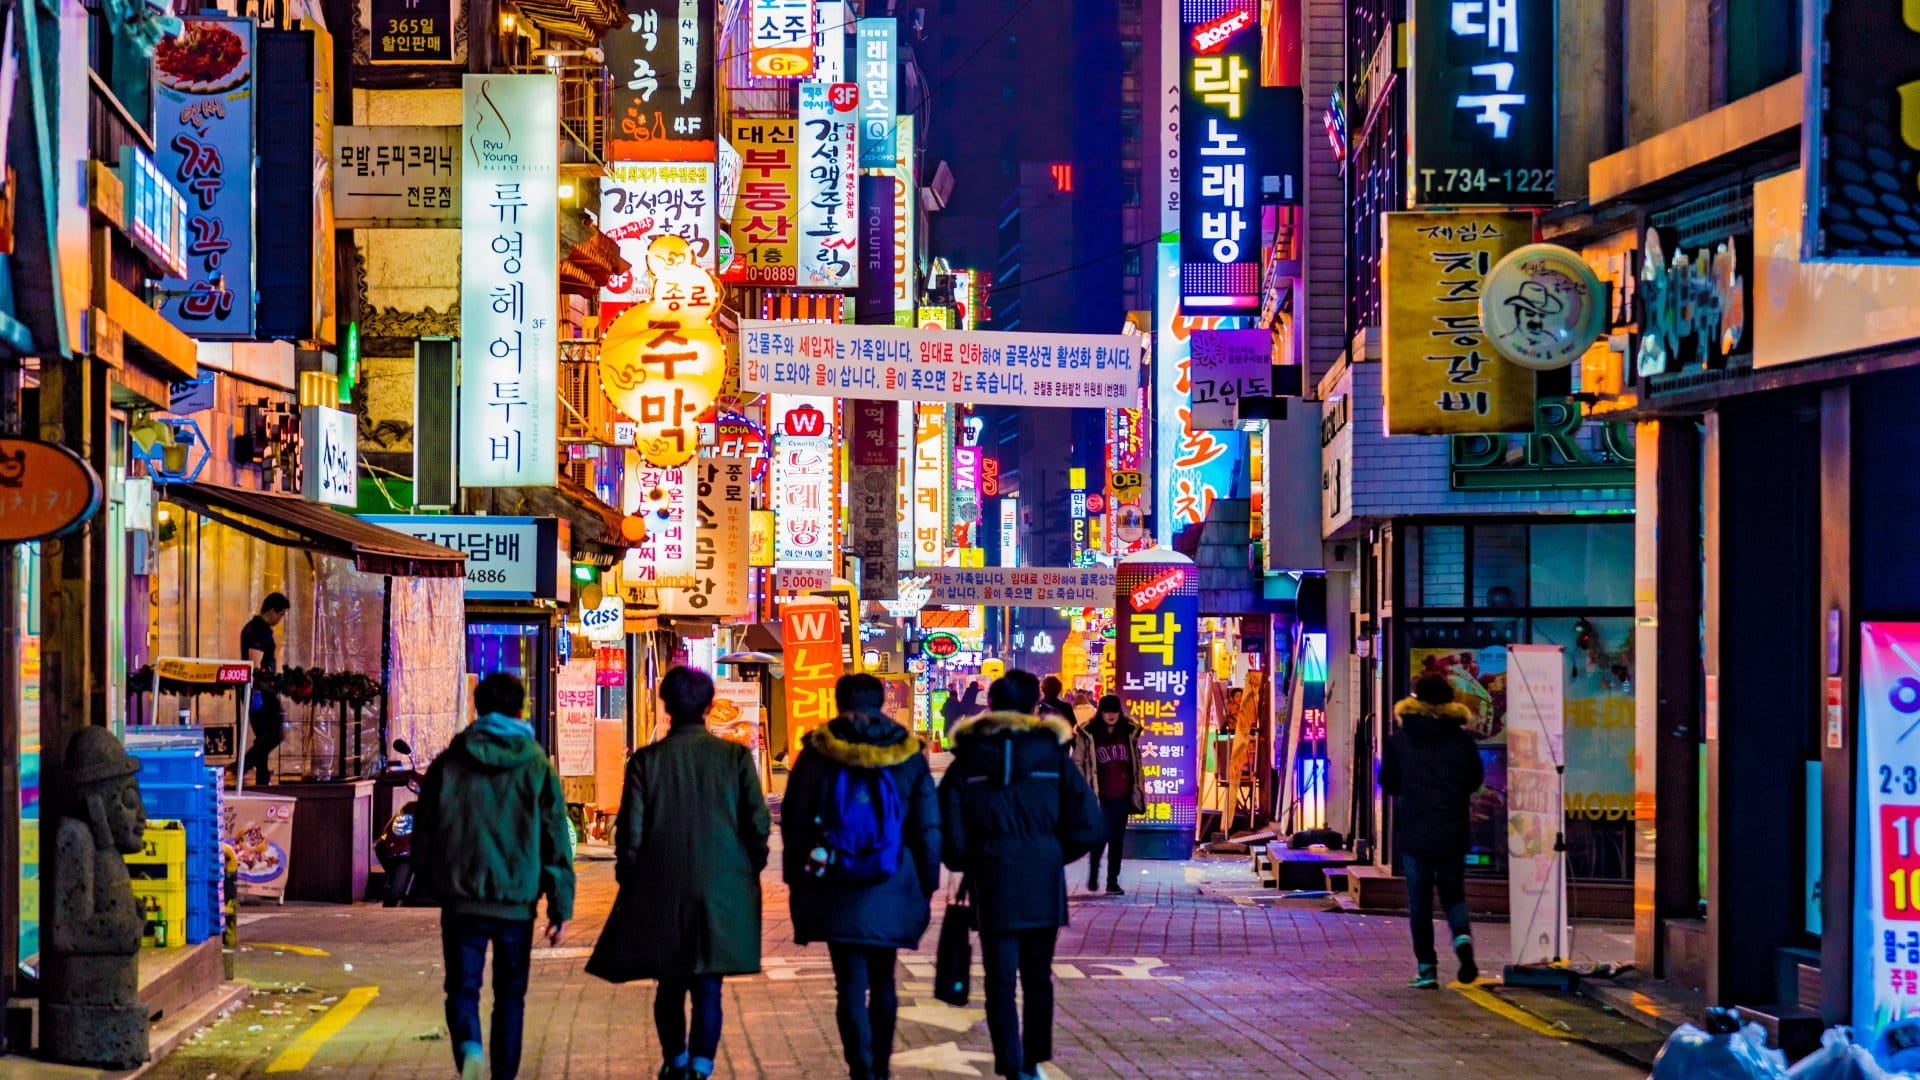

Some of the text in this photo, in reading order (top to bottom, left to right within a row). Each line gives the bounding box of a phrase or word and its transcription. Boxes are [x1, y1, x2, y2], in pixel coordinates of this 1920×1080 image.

[388, 18, 434, 35] 365일
[757, 15, 807, 42] 소주
[1195, 18, 1245, 51] ROCK
[382, 36, 441, 52] 할인판매
[768, 56, 798, 72] 6F
[865, 40, 889, 118] 레지던스
[833, 86, 857, 105] 3F
[674, 116, 702, 135] 4F
[737, 125, 795, 144] 대신
[482, 139, 503, 153] Ryu
[482, 151, 519, 164] Young
[1194, 55, 1250, 264] 락 노래방
[1419, 168, 1556, 193] T.734-1222
[406, 186, 452, 209] 전문점
[604, 187, 707, 221] 감성맥주
[739, 148, 793, 245] 부동산
[1416, 221, 1505, 243] 제임스
[748, 247, 784, 264] 1층
[608, 273, 629, 289] 3F
[661, 281, 712, 311] 종로
[487, 183, 528, 474] 류영헤어투비
[531, 319, 546, 329] 3F
[1424, 250, 1492, 417] 치즈등갈비
[747, 331, 1132, 371] 건물주와 세입자는 가족입니다. 임대료 인하하여 골목상권 활성화 합시다.
[640, 319, 698, 453] 주막
[747, 359, 770, 384] 갑이
[774, 361, 811, 386] 도와야
[815, 362, 837, 387] 을이
[840, 364, 881, 390] 삽니다.
[885, 367, 907, 391] 을이
[911, 369, 947, 393] 죽으면
[951, 370, 974, 393] 갑도
[975, 371, 1028, 396] 죽습니다.
[790, 413, 818, 433] W
[725, 464, 743, 502] 종로
[982, 457, 999, 497] DVD
[1112, 473, 1142, 487] OB
[784, 449, 826, 548] 노래방
[917, 447, 938, 553] 노래방
[1072, 494, 1084, 516] 만화
[664, 468, 685, 560] 매운갈비찜
[1073, 519, 1084, 542] PC
[955, 573, 1006, 585] 가족입니다.
[1010, 573, 1039, 585] 임대료
[947, 587, 980, 600] 삽니다.
[983, 587, 1001, 599] 을이
[1004, 588, 1033, 600] 죽으면
[1036, 588, 1054, 600] 갑도
[1056, 588, 1099, 601] 죽습니다.
[1132, 577, 1180, 609] ROCK
[582, 608, 620, 628] Cass
[790, 612, 828, 641] W
[1130, 612, 1182, 667] 락
[1123, 670, 1189, 696] 노래방
[558, 690, 595, 708] 안주무료
[791, 648, 838, 751] 노래
[1161, 767, 1178, 777] 이전
